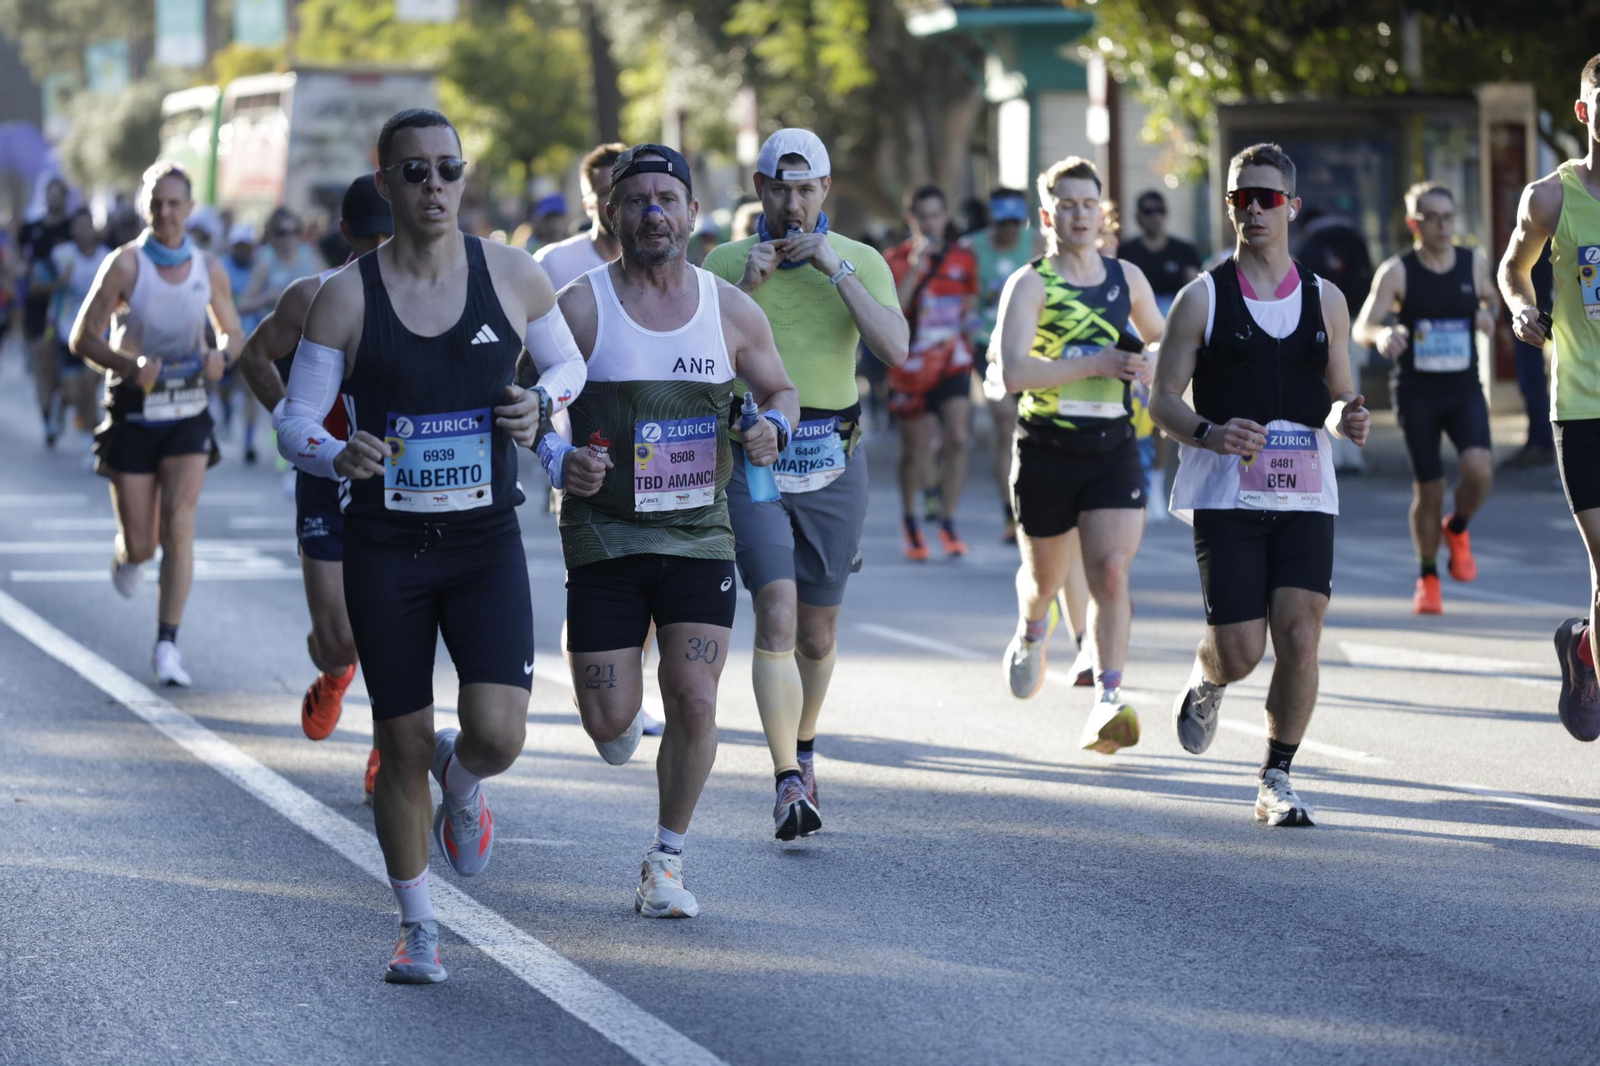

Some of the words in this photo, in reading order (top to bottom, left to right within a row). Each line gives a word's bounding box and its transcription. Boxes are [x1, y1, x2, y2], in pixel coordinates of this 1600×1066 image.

[672, 357, 715, 375] ANR
[421, 418, 478, 434] ZURICH
[668, 422, 716, 438] ZURICH
[1270, 435, 1311, 446] ZURICH
[423, 448, 454, 462] 6939
[670, 450, 695, 464] 8508
[795, 446, 820, 456] 6440
[1270, 458, 1294, 468] 8481
[395, 464, 482, 488] ALBERTO
[635, 474, 663, 490] TBD
[668, 470, 716, 489] AMANCI
[1267, 473, 1296, 488] BEN
